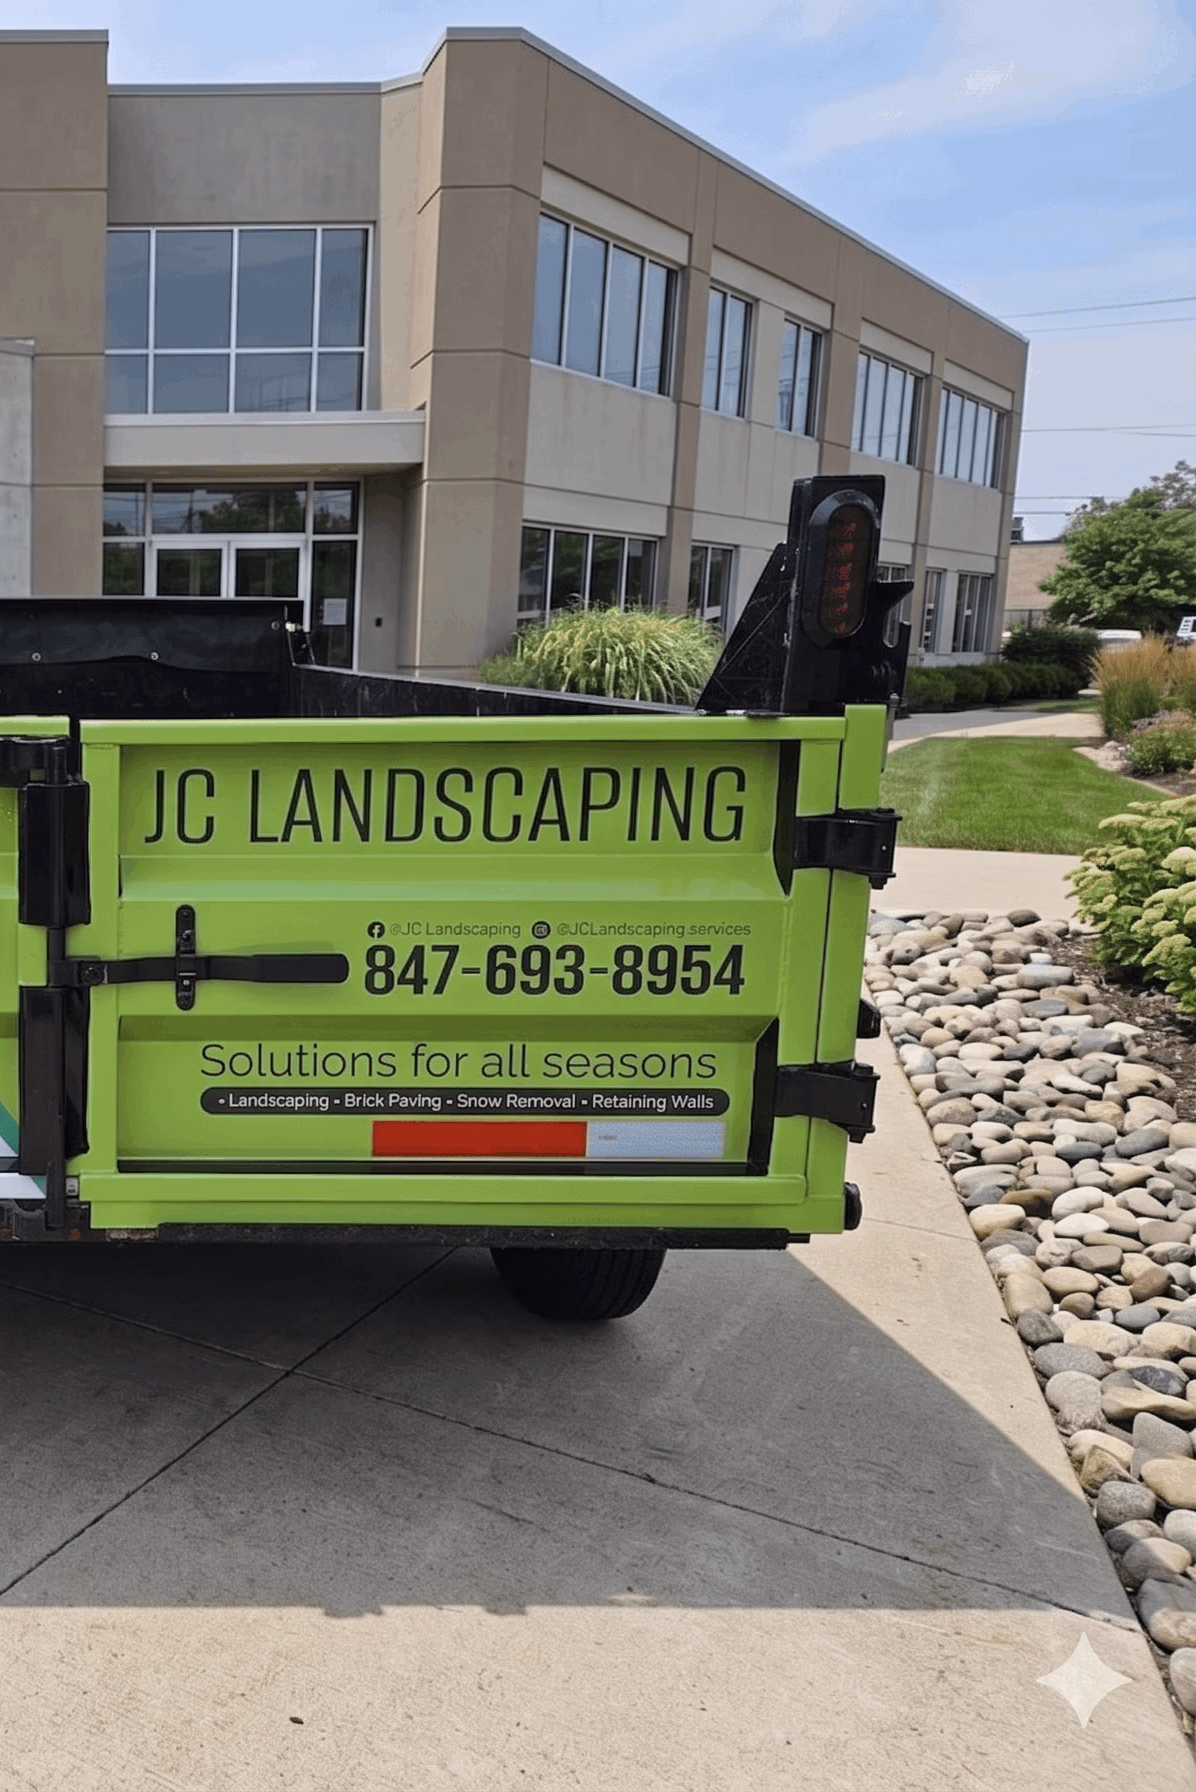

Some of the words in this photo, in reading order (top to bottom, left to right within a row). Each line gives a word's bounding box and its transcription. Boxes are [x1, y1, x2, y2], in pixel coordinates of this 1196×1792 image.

[144, 769, 215, 844] JC
[249, 766, 746, 843] LANDSCAPING
[390, 922, 422, 936] @JC
[426, 922, 521, 938] Landscaping
[364, 944, 745, 995] 847-693-8954
[201, 1043, 397, 1077] Solutions
[411, 1043, 469, 1077] for
[481, 1043, 530, 1078] all
[542, 1053, 717, 1078] seasons
[229, 1093, 329, 1111] Landscaping
[345, 1093, 385, 1107] Brick
[389, 1093, 442, 1111] Paving
[457, 1094, 503, 1108] Snow
[506, 1094, 576, 1108] Removal
[592, 1094, 667, 1112] Retaining
[671, 1094, 714, 1109] Walls
